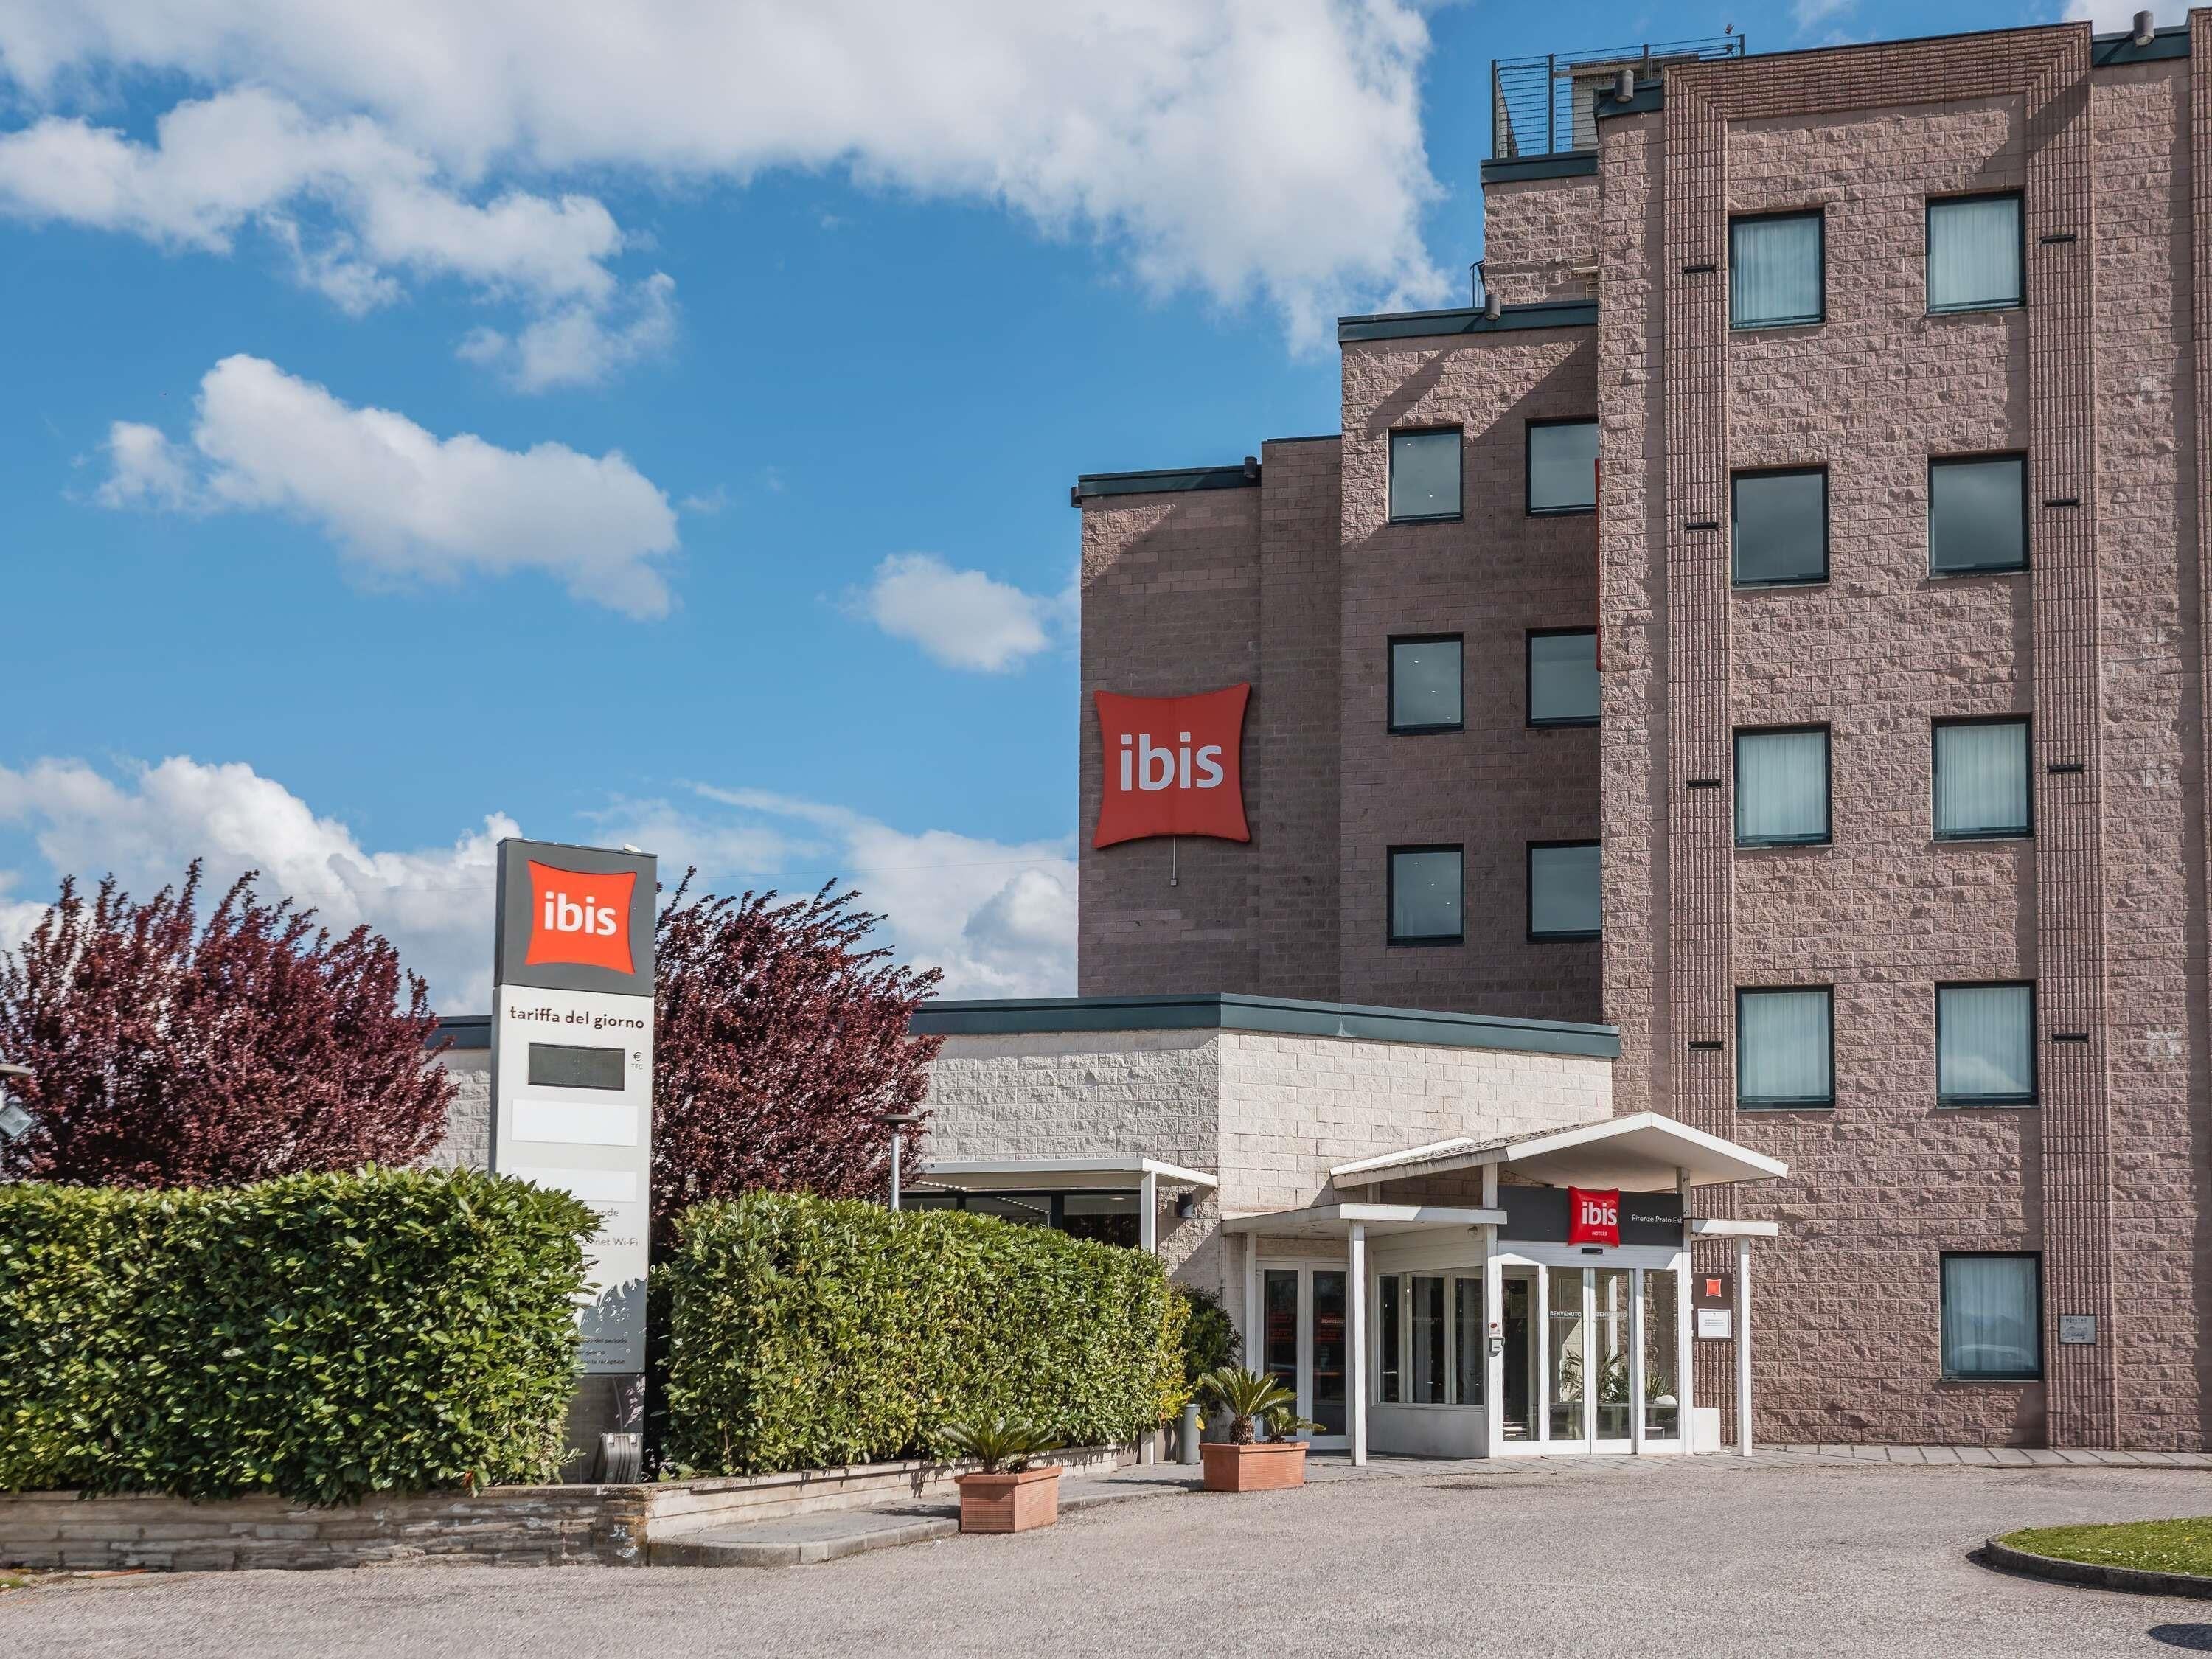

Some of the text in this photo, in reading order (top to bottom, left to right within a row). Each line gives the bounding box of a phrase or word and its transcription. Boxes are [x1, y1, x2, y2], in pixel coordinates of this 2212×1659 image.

[1121, 731, 1224, 791] ibis
[544, 891, 617, 936] ibis
[510, 1006, 644, 1030] tariffa del giorno
[1582, 1201, 1617, 1226] ibis
[1632, 1214, 1654, 1222] Firenze
[1655, 1215, 1672, 1223] Prato
[613, 1238, 638, 1246] Wi-Fi
